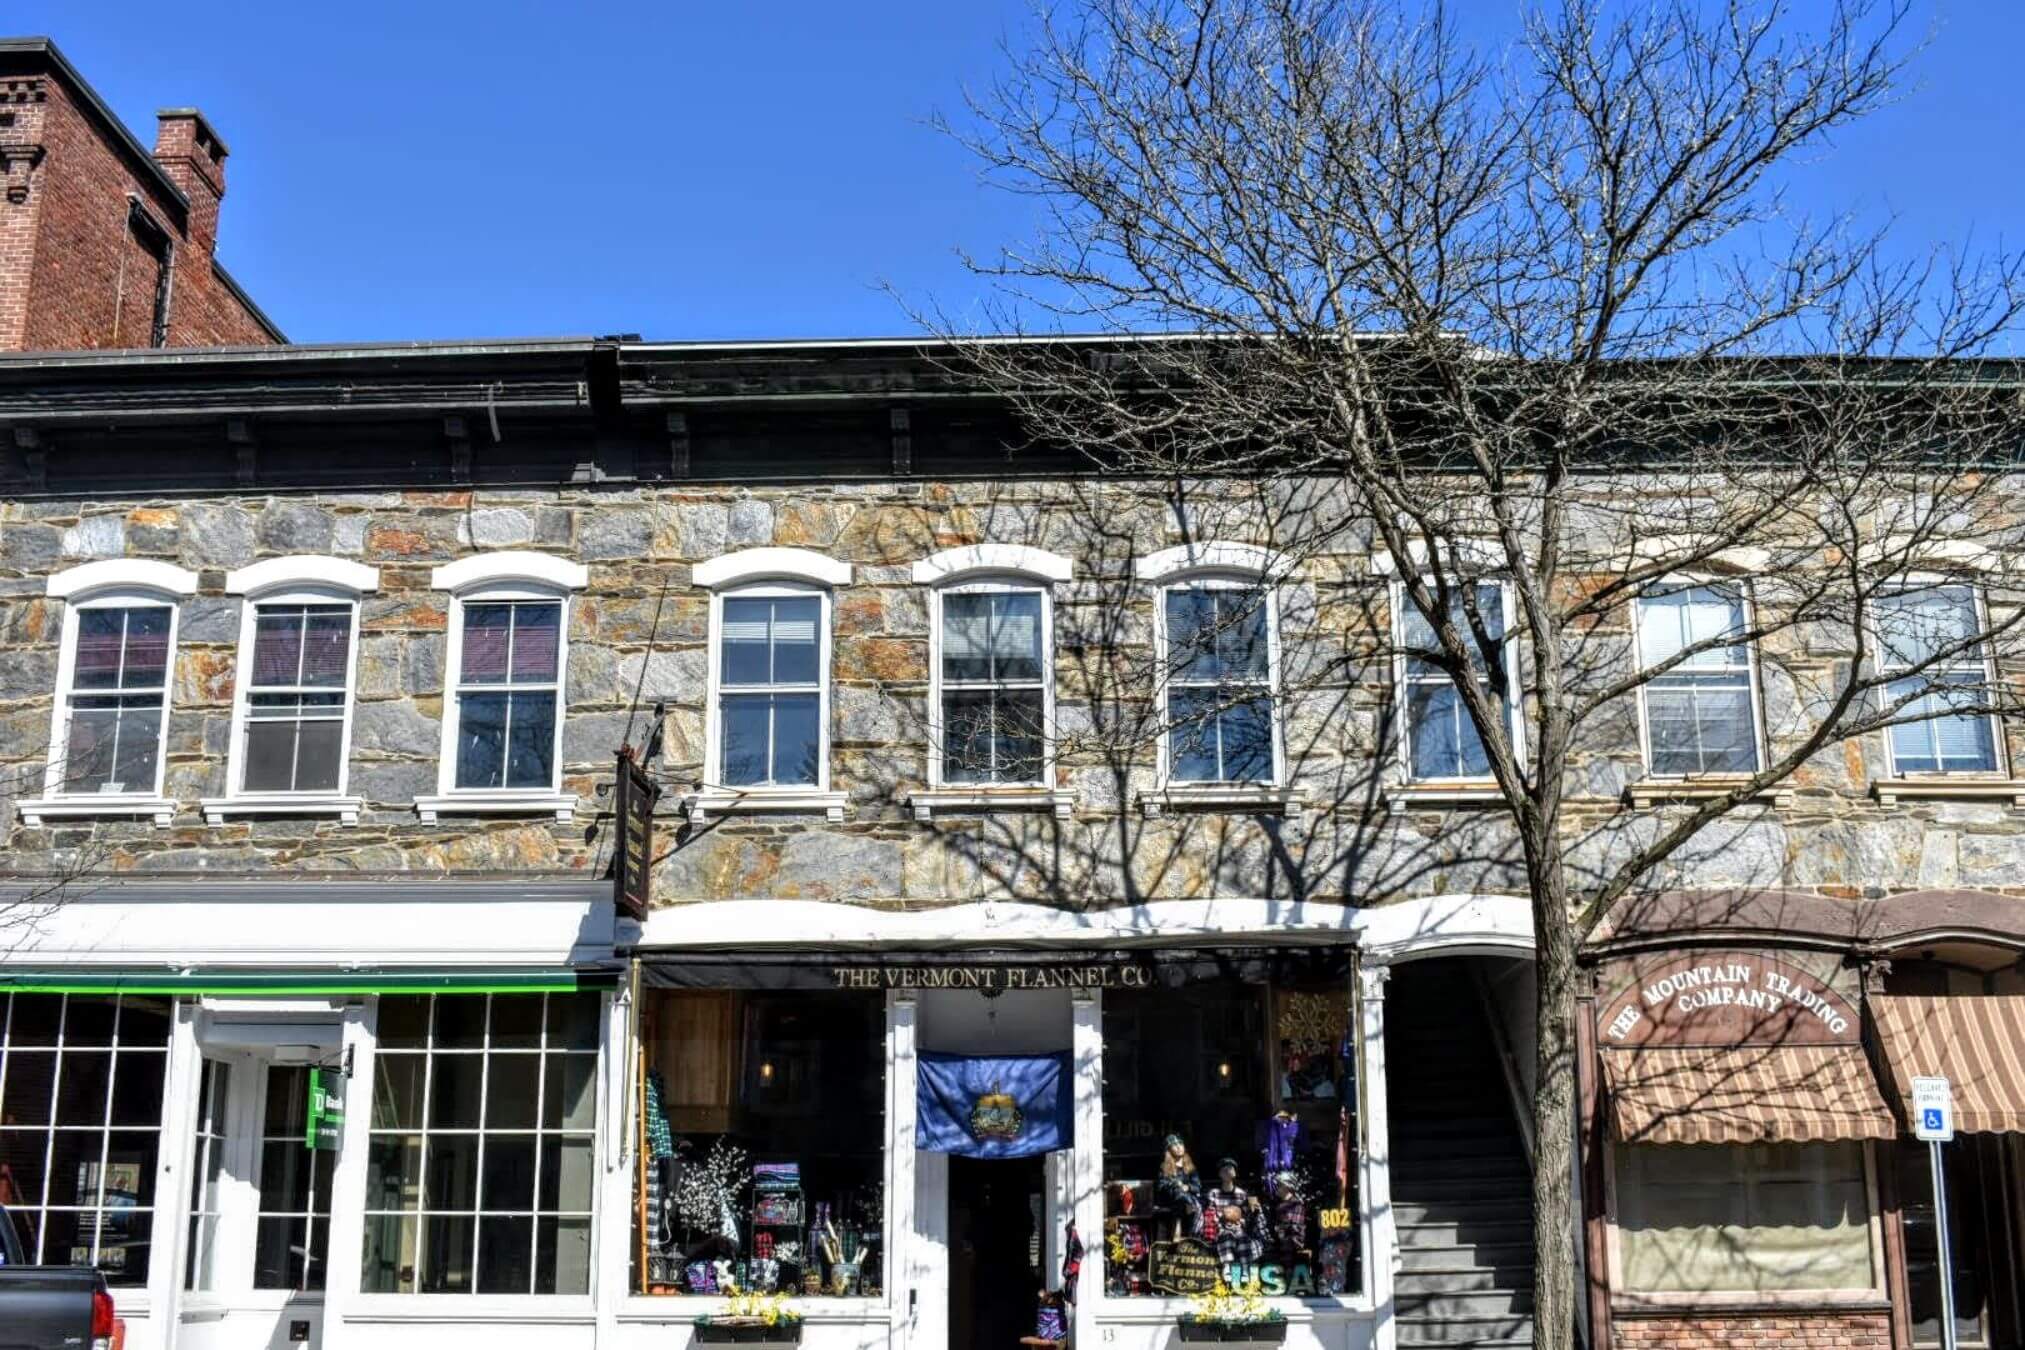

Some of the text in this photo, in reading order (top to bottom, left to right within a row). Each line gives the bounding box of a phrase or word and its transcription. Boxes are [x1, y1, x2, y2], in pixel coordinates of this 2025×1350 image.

[834, 967, 880, 988] THE
[884, 967, 996, 988] VERMONT
[1006, 966, 1115, 988] FLANNEL
[1606, 964, 1848, 1040] THE MOUNTAIN TRADING
[1678, 986, 1783, 1013] COMPANY
[1320, 1208, 1350, 1229] 802
[1229, 1262, 1317, 1296] USA
